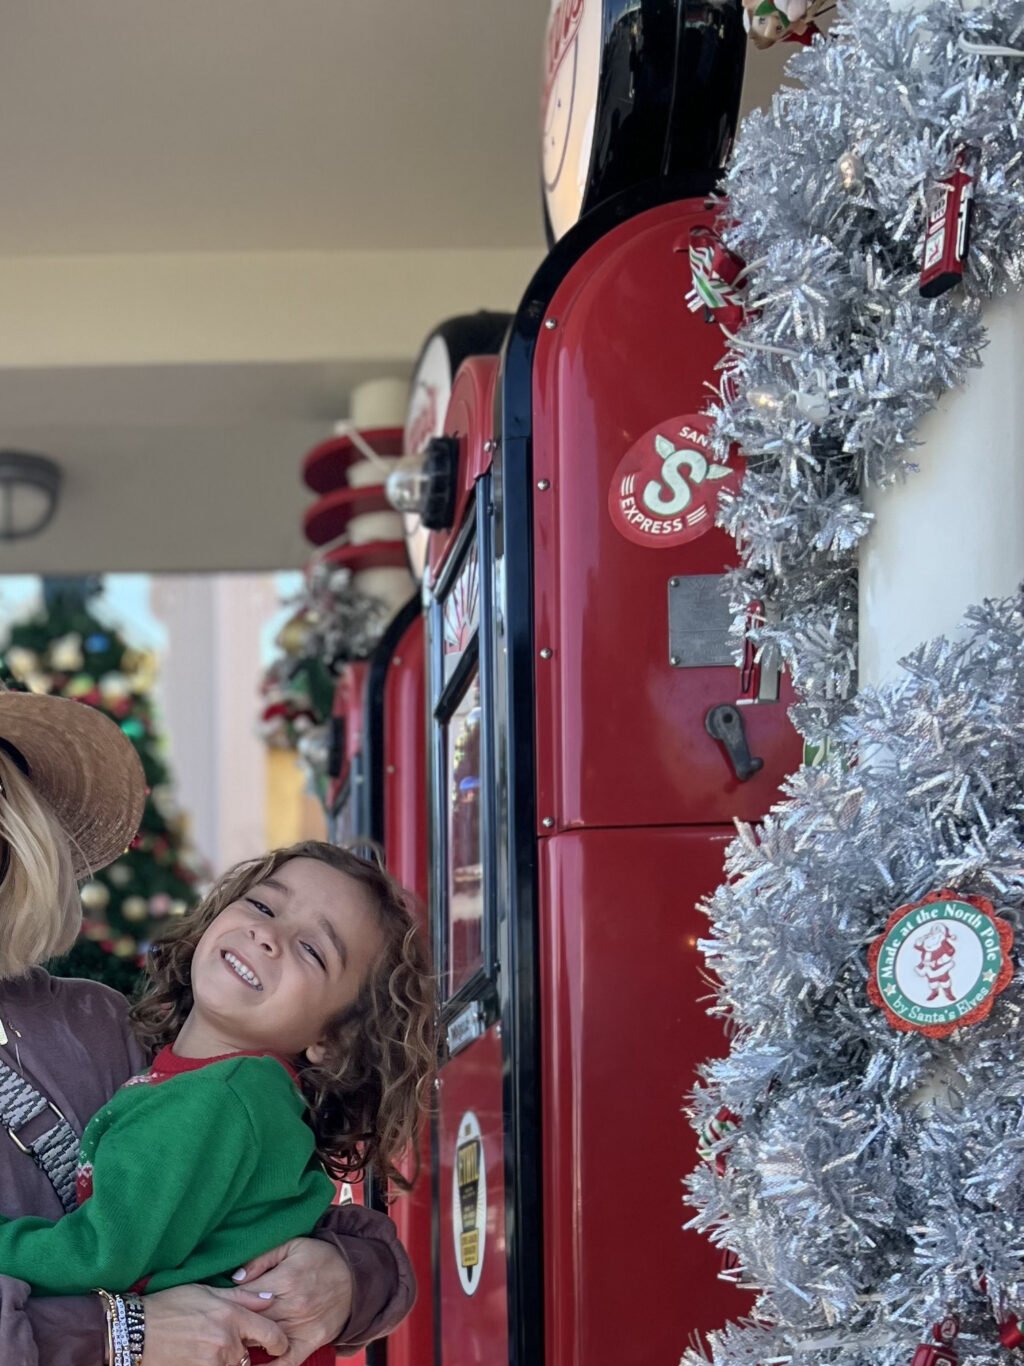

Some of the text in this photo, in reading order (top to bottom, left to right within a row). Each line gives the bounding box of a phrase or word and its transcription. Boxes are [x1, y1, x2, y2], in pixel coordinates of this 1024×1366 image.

[621, 497, 683, 534] EXPRESS
[881, 904, 1001, 978] Made at the North Pole
[892, 986, 989, 1023] by Santa's Elves
[128, 1303, 144, 1354] LOVE
